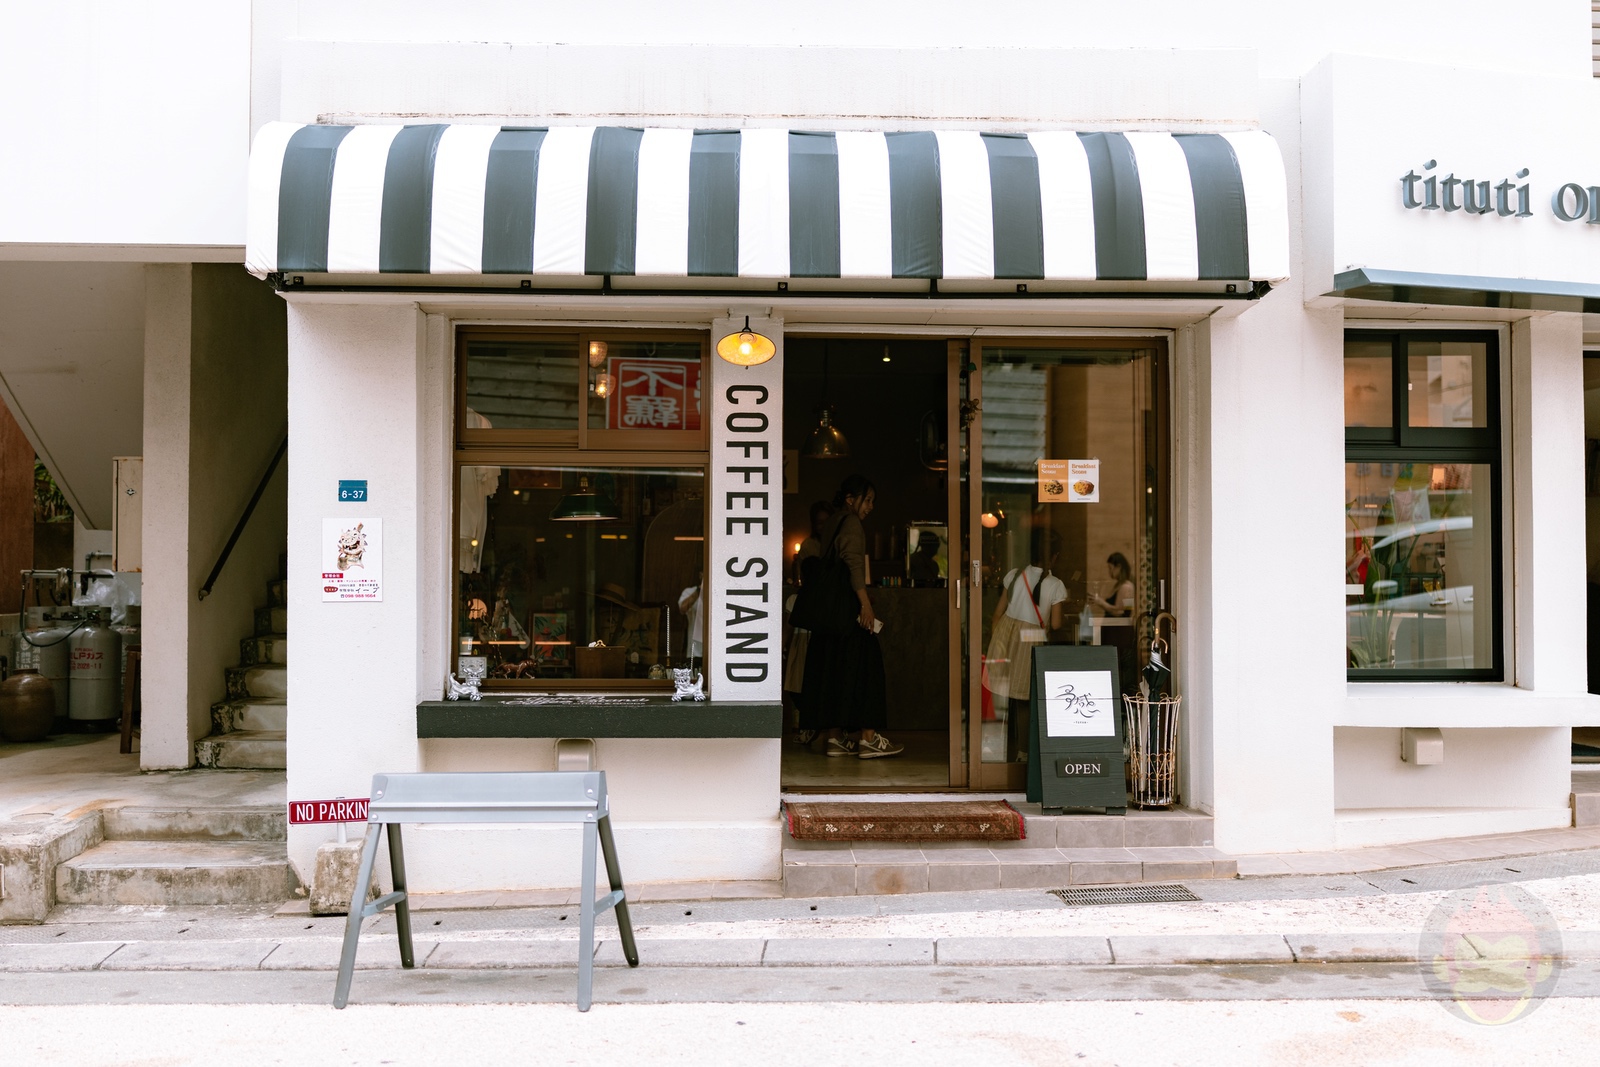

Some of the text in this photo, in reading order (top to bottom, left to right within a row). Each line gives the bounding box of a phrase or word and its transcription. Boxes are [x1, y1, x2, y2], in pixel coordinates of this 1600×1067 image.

[1399, 158, 1534, 219] tituti
[341, 489, 364, 499] 6-37
[725, 384, 769, 684] COFFEE STAND
[1064, 763, 1102, 775] OPEN
[296, 800, 370, 821] NO PARKIN
